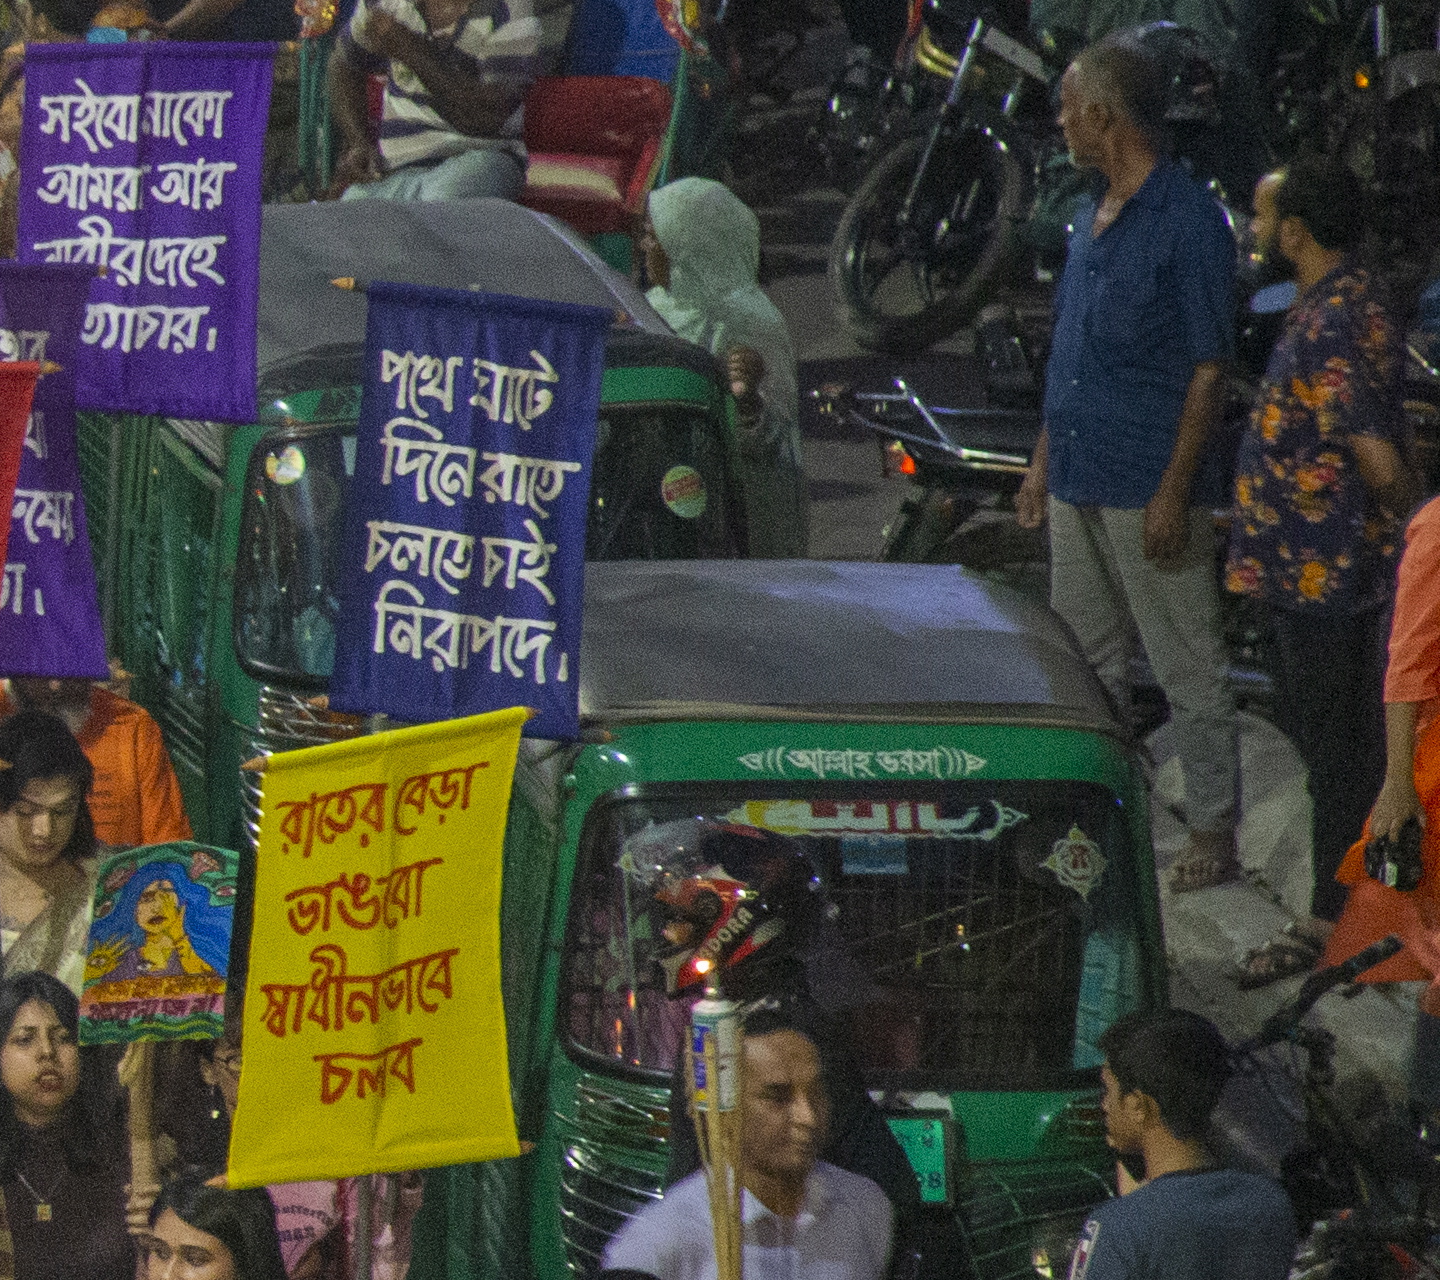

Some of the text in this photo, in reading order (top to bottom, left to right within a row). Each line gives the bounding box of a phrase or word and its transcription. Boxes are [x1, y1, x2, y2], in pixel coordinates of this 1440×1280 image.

[39, 78, 141, 153] সইবো
[151, 158, 237, 210] আর
[146, 236, 226, 287] দেহে
[381, 350, 559, 430] পথে ঘাটে
[381, 417, 582, 518] দিনে রাতে
[365, 520, 557, 605] চলতে চাই
[276, 761, 489, 859] রাতের বেড়া
[285, 857, 443, 936] ভাঙবো
[260, 943, 460, 1038] স্বাধীনভাবে
[314, 1038, 423, 1105] চলব
